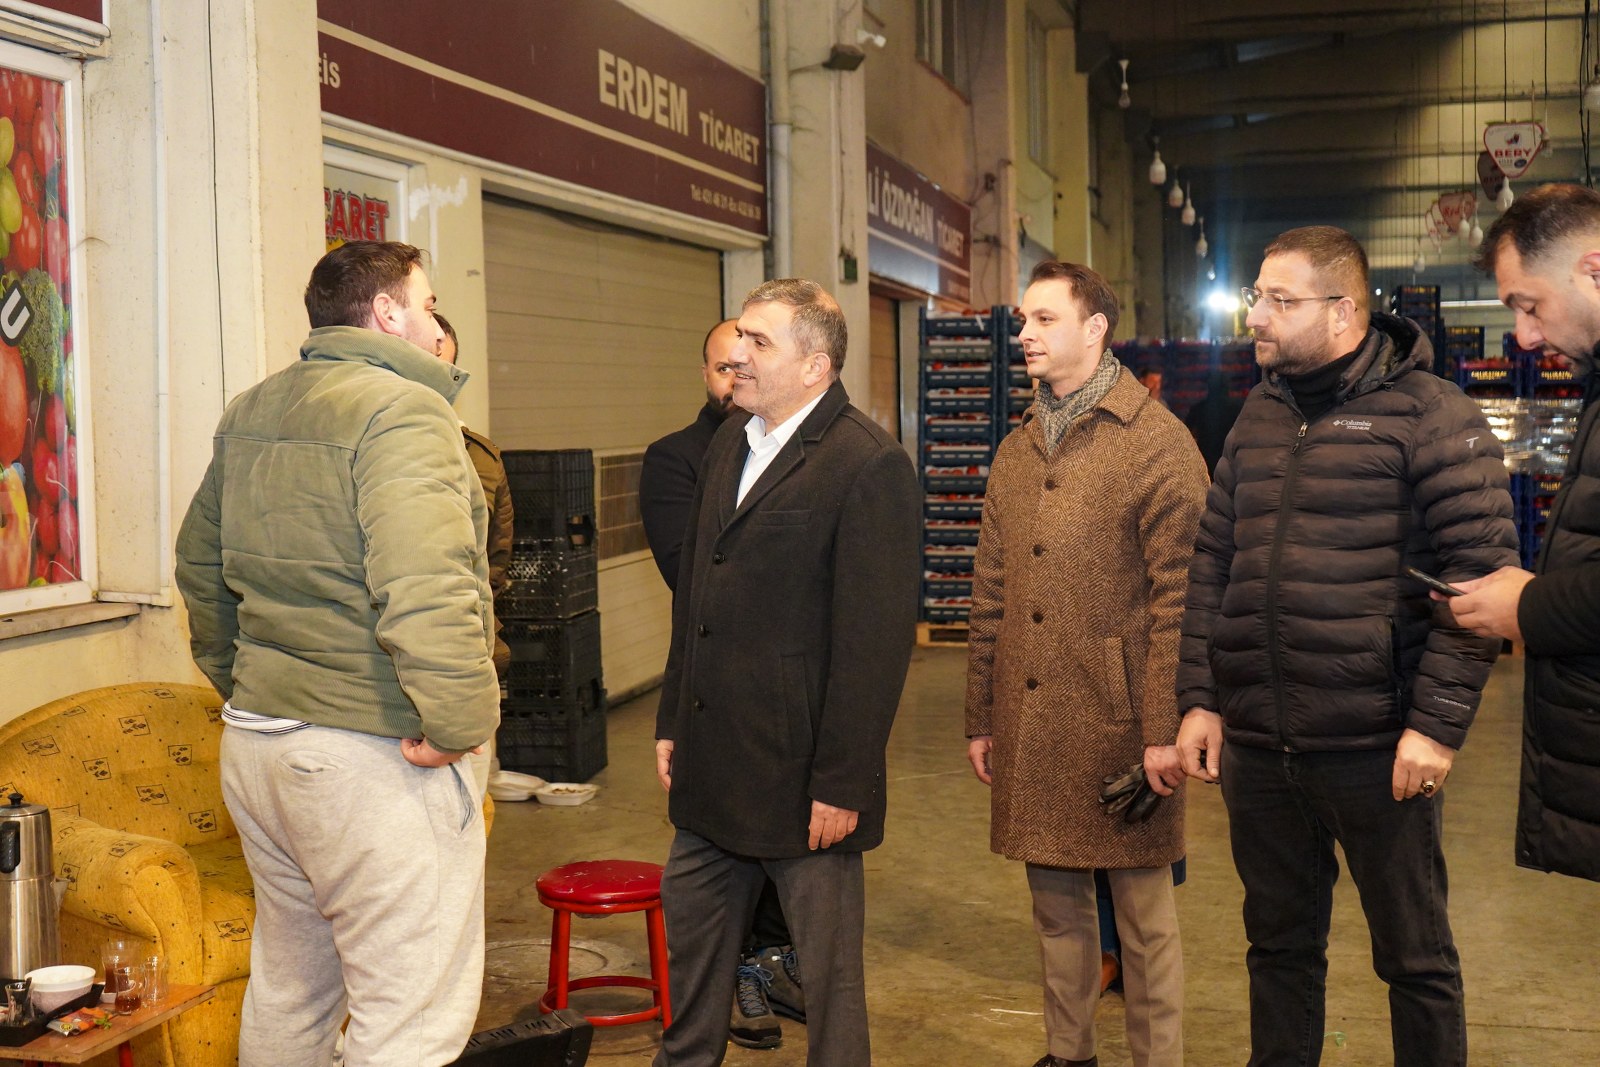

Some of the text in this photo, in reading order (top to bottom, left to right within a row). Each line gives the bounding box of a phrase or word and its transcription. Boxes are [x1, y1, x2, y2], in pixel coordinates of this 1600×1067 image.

[599, 49, 759, 165] ERDEM TİCARET
[882, 170, 934, 244] ÖZDOĞAN
[1340, 419, 1372, 427] Columbia
